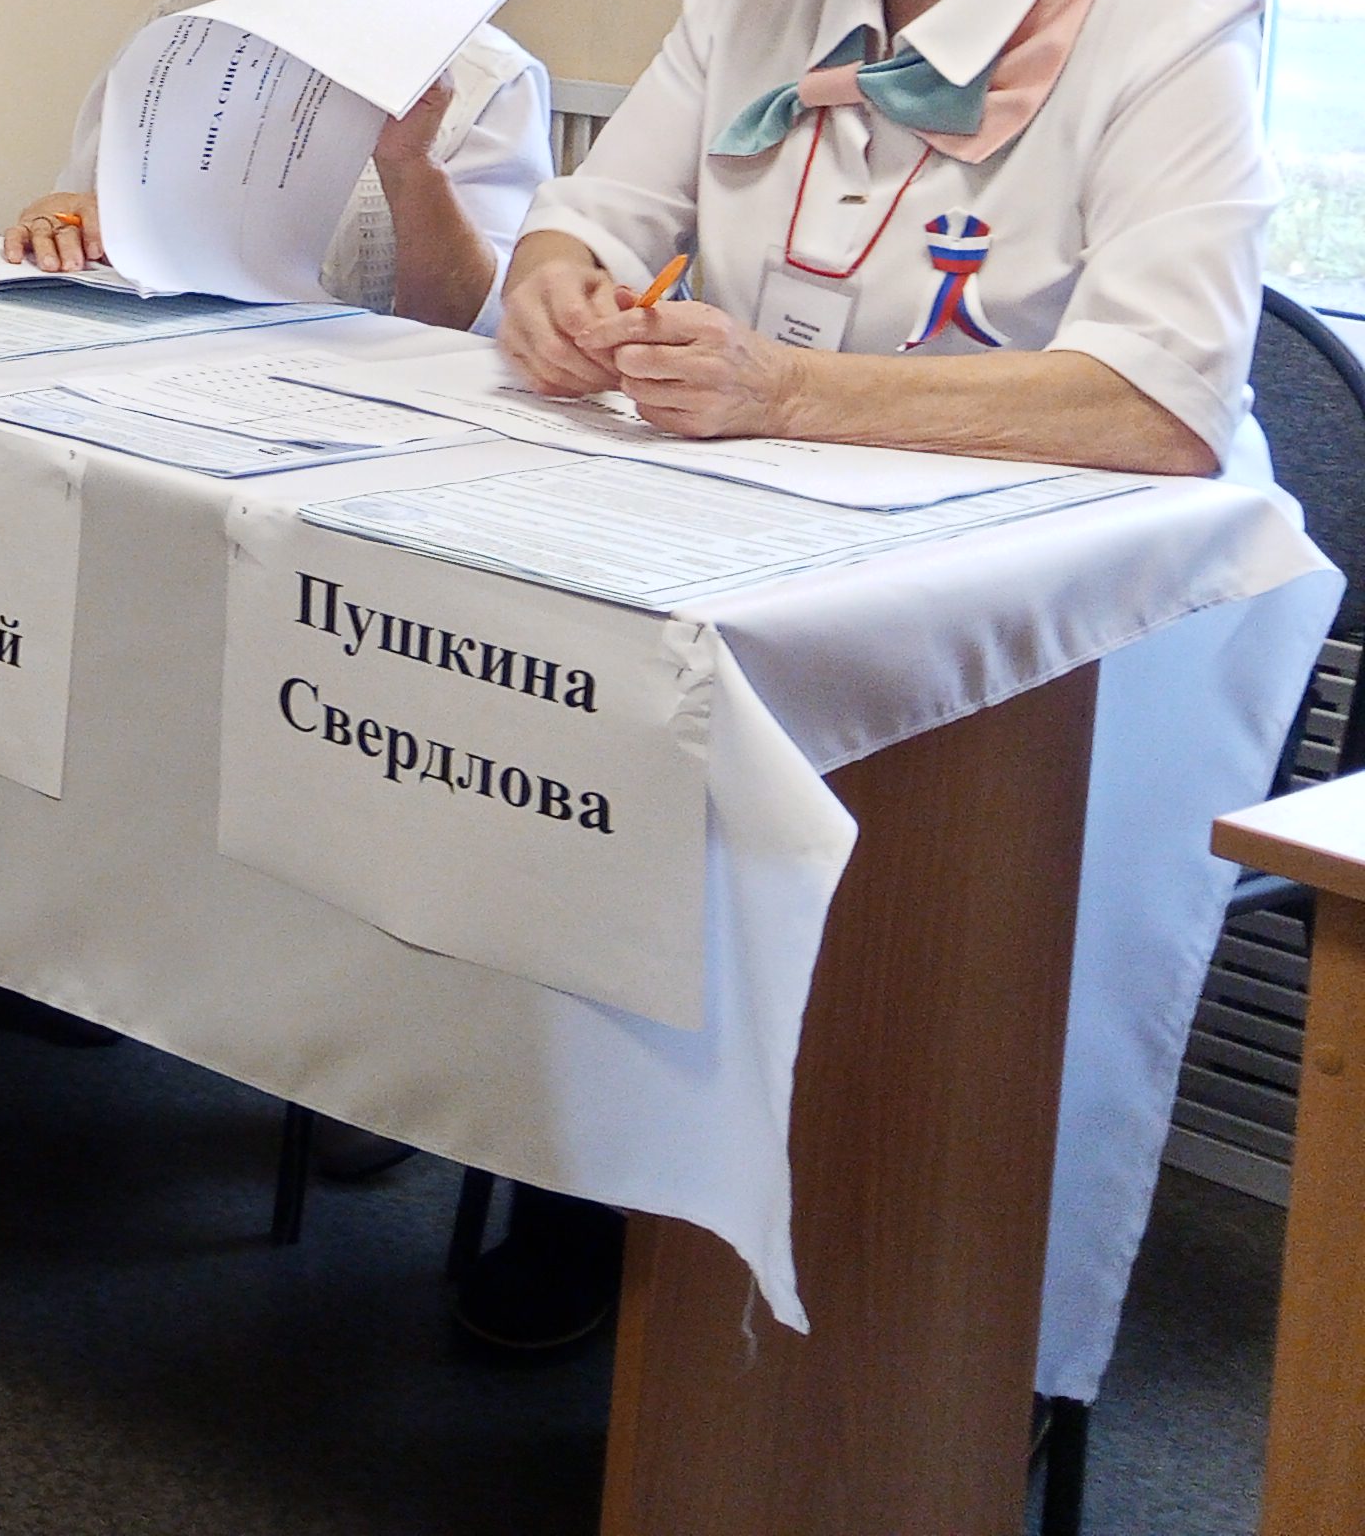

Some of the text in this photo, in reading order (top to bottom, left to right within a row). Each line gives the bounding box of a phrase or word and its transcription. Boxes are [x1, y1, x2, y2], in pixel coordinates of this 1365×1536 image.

[200, 33, 251, 171] КНИГА СПИСКА
[295, 571, 598, 713] Пушкина
[280, 678, 614, 834] Свердлова
